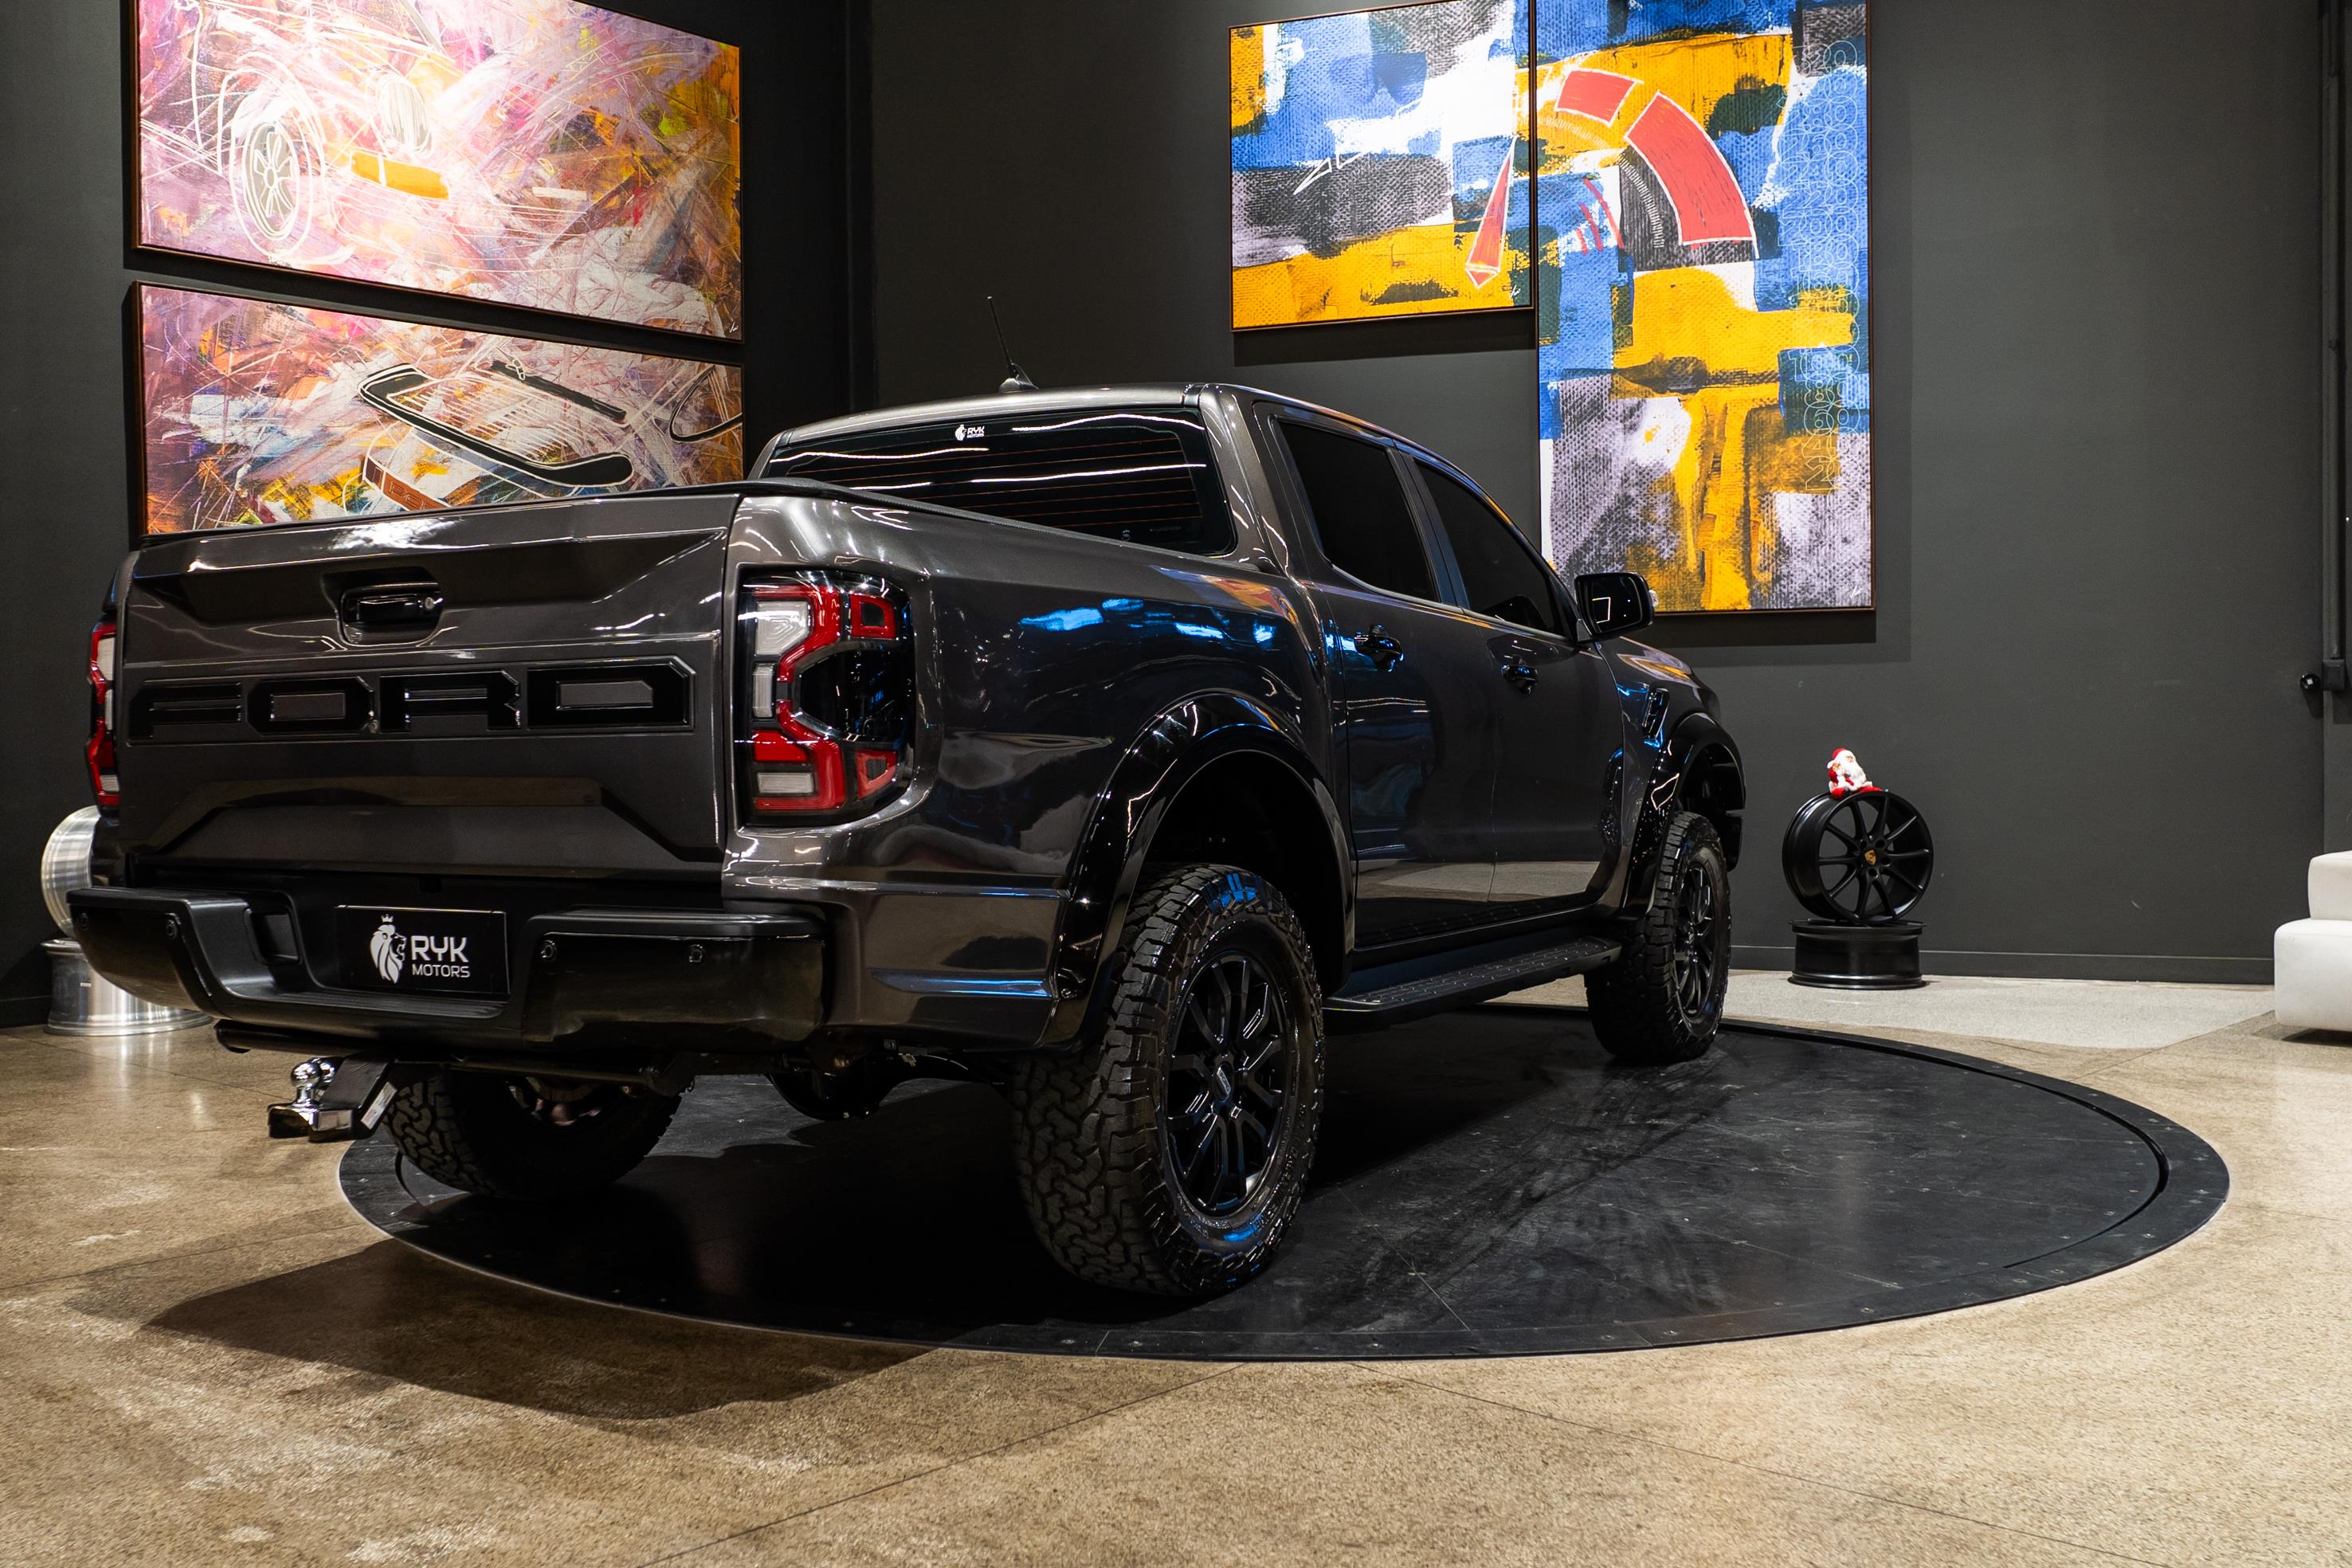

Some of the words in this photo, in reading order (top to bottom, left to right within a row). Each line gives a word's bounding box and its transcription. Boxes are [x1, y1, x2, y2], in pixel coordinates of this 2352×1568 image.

[1778, 206, 1859, 246] 200
[1787, 344, 1860, 382] 100
[1804, 372, 1860, 408] 80
[967, 425, 985, 435] RYK
[1803, 400, 1860, 436] 60
[129, 658, 693, 739] FORD
[410, 935, 469, 963] RYK
[411, 962, 471, 978] MOTORS
